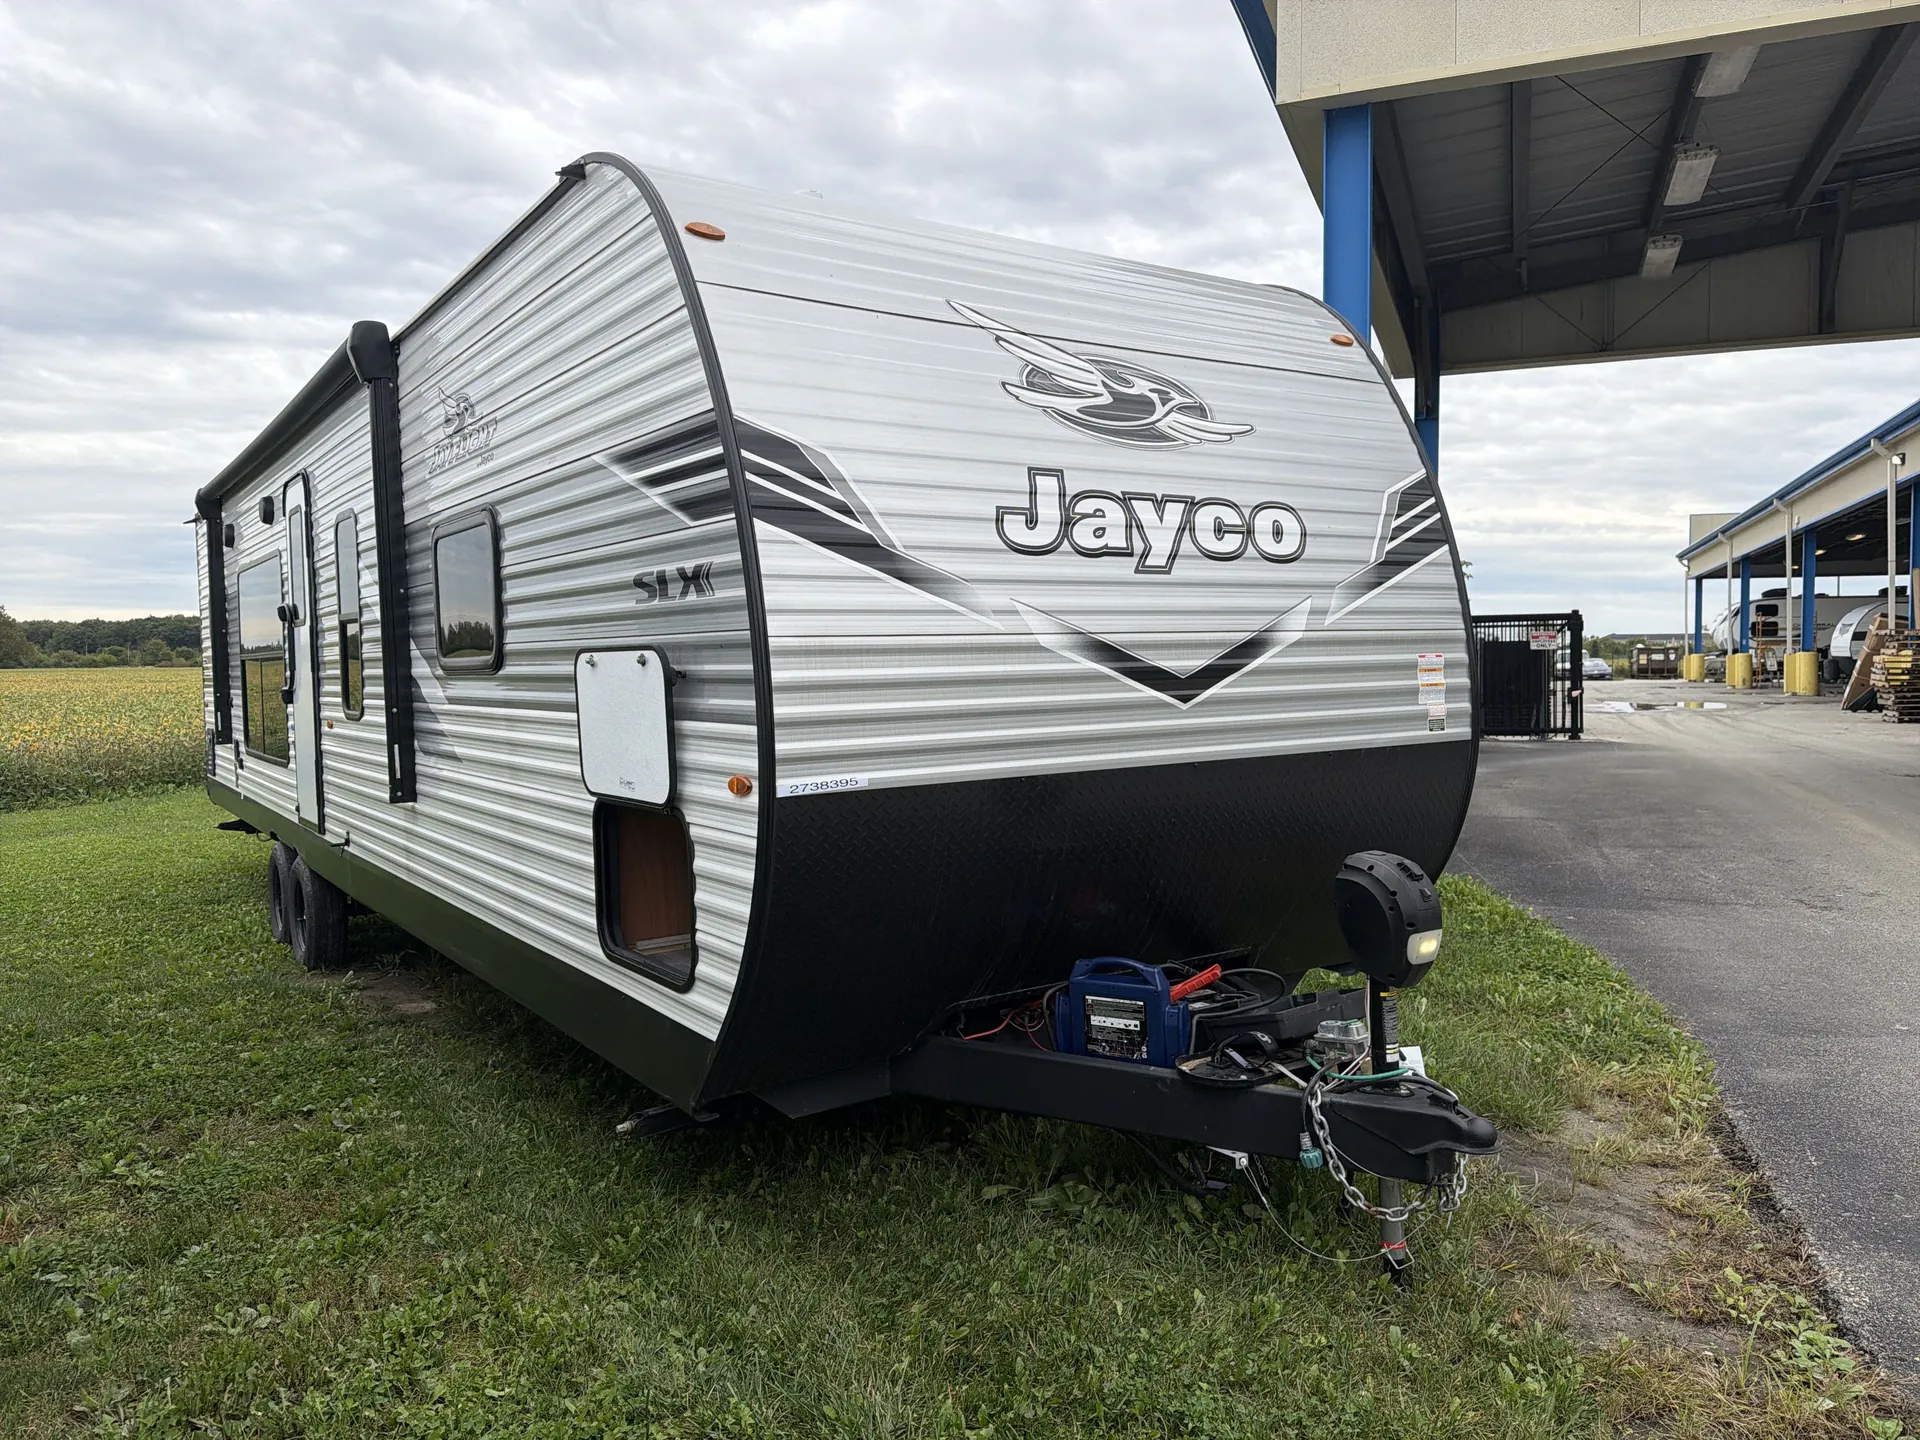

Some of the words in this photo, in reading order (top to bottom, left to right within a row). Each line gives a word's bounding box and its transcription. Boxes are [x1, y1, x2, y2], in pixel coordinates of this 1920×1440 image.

[995, 466, 1307, 575] Jayco
[632, 561, 716, 605] SLX
[789, 777, 859, 794] 2738395
